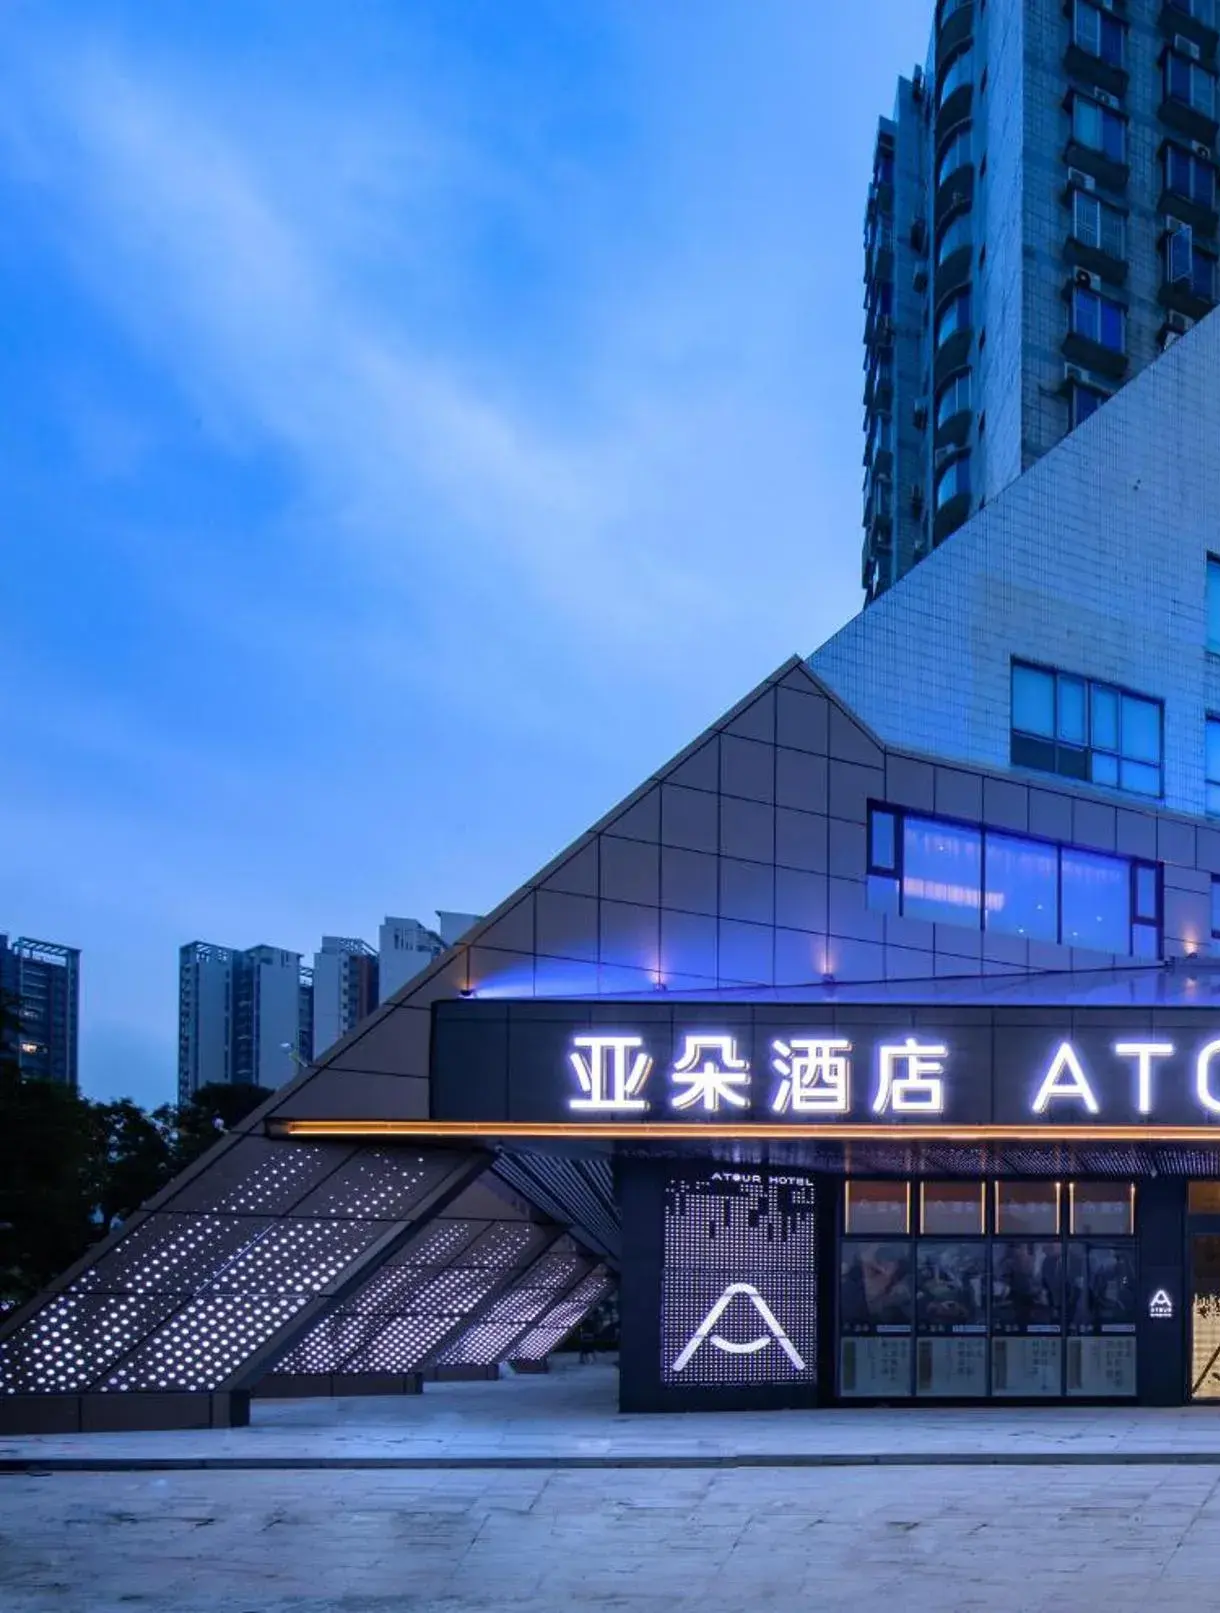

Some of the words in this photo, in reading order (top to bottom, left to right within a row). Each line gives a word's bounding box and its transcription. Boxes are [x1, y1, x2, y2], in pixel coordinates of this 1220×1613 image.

[569, 1034, 948, 1114] 亚朵酒店
[711, 1172, 761, 1183] ATOUR
[768, 1176, 814, 1186] HOTEL
